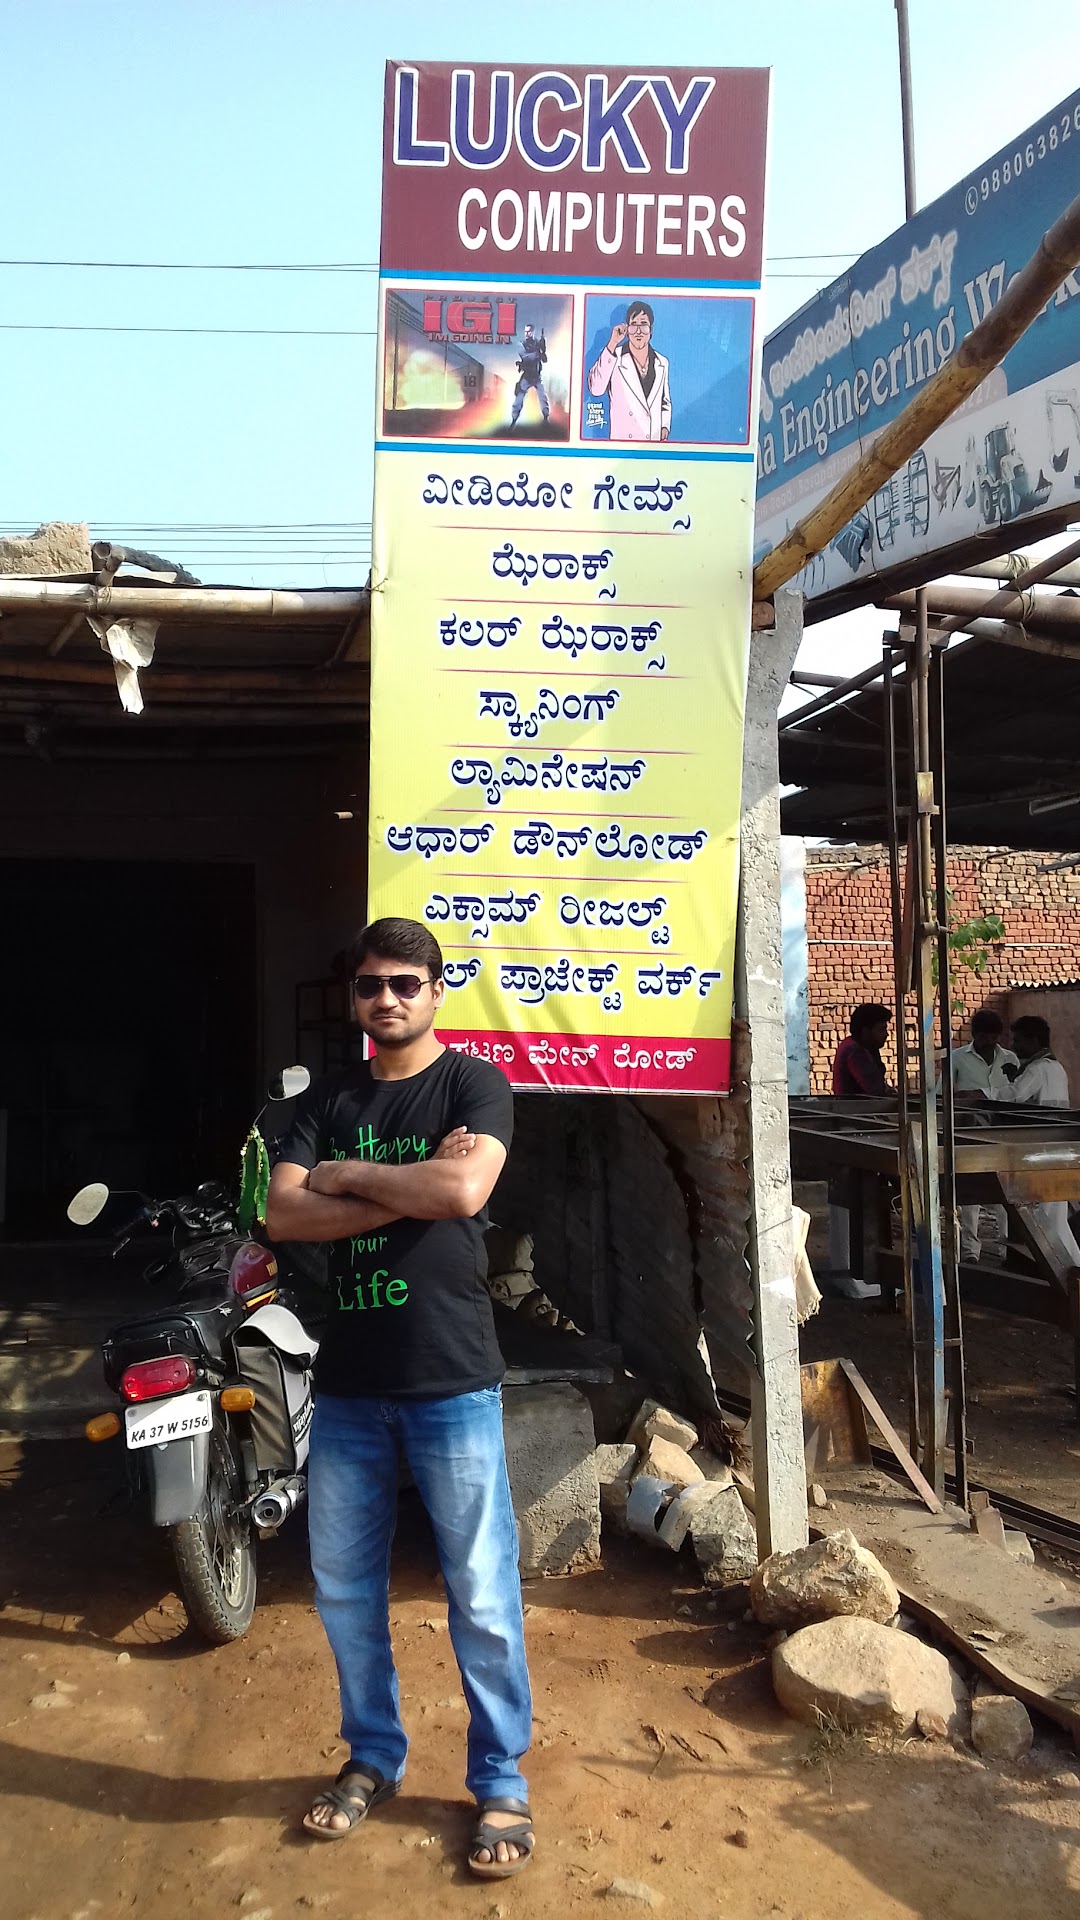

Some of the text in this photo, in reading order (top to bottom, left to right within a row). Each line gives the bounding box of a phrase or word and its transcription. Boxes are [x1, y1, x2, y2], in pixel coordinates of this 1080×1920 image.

[393, 66, 716, 174] LUCKY
[457, 188, 747, 258] COMPUTERS
[422, 300, 517, 335] IGI
[450, 333, 494, 344] GOING
[495, 335, 512, 345] IN
[779, 306, 957, 456] Engineering
[422, 472, 691, 530] ವೀಡಿಯೋ ಗೇಮ್ಸ್
[492, 543, 617, 599] ಝೆರಾಕ್ಸ್
[440, 612, 665, 671] ಕಲರ್ ಝೆರಾಕ್ಸ್
[479, 688, 620, 738] ಸ್ಕ್ಯಾನಿಂಗ್
[451, 753, 646, 805] ಲ್ಯಾಮಿನೇಷನ್
[387, 823, 495, 859] ಆಧಾರ್
[425, 890, 670, 945] ಎಕ್ಸಾಮ್ ರೀಜಲ್ಟ್
[442, 958, 482, 988] ಲ್
[501, 959, 622, 1011] ಪ್ರಾಜೇಕ್ಟ್
[528, 1039, 600, 1070] ಮೇನ್
[613, 1042, 697, 1070] ರೋಡ್
[355, 1124, 432, 1164] Happy
[335, 1269, 409, 1311] Life
[131, 1416, 209, 1443] KA 37 W 5156
